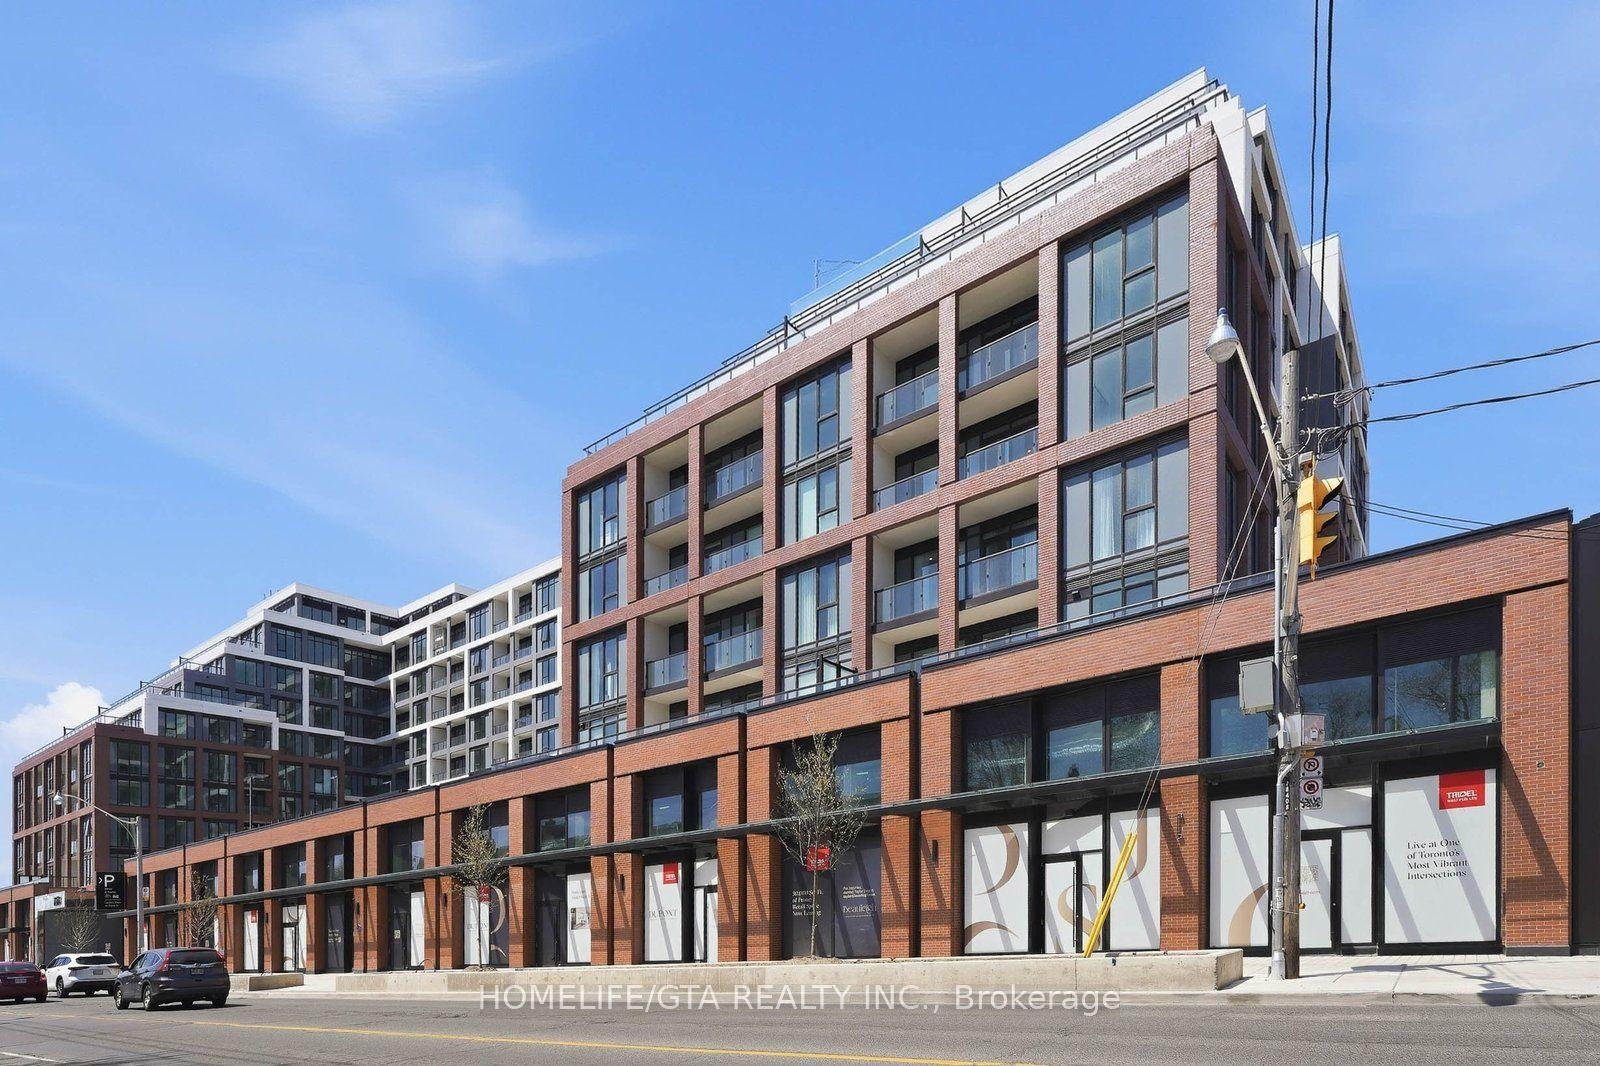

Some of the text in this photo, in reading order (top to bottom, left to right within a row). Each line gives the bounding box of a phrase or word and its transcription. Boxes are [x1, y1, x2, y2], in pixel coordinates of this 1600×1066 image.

[1446, 790, 1478, 800] TRIDEL
[1407, 839, 1460, 850] Live at One
[1406, 849, 1460, 860] of Toronto's
[1407, 859, 1469, 870] Most Vibrant
[1407, 869, 1467, 880] Intersections
[104, 874, 115, 887] P
